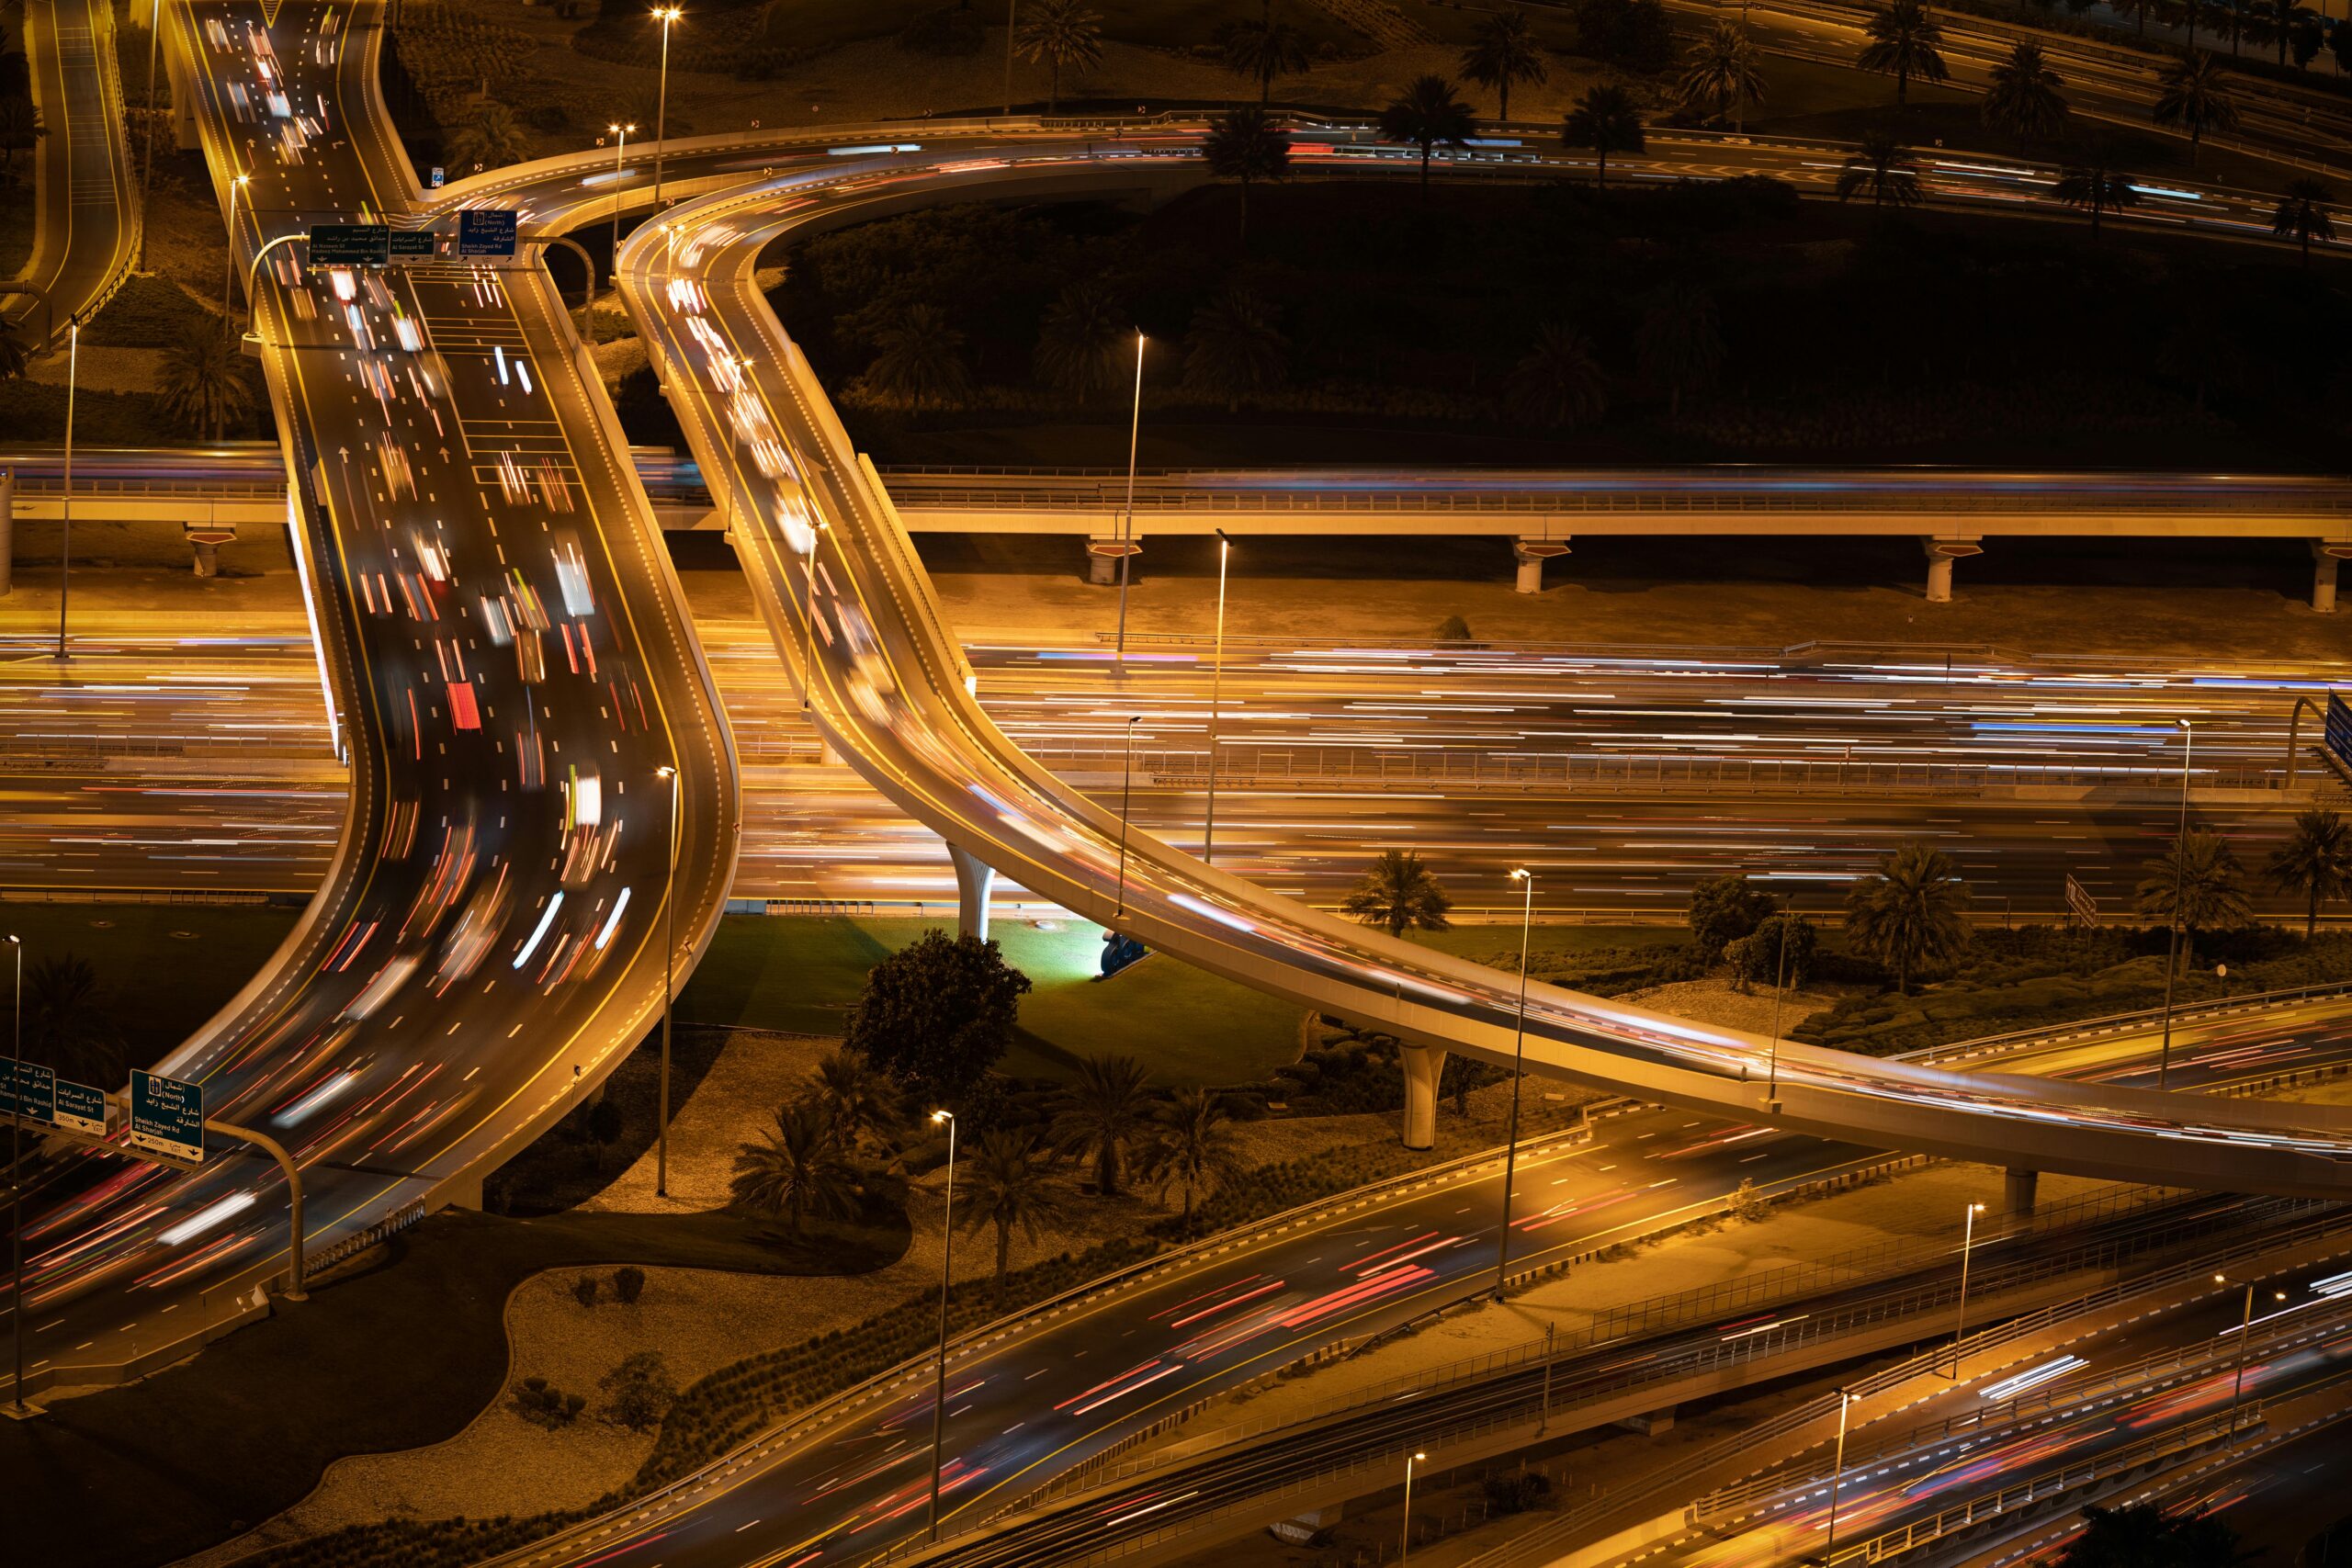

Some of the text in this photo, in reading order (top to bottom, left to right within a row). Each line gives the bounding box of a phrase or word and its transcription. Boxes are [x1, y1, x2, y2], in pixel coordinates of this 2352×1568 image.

[35, 1069, 51, 1078] شارع
[13, 1076, 29, 1085] محد
[86, 1096, 102, 1104] شارع
[162, 1091, 185, 1104] (North)
[33, 1098, 51, 1108] Rashid
[65, 1100, 86, 1111] Sarayat
[146, 1098, 199, 1116] شارع الشيخ زايد
[134, 1116, 180, 1134] Sheikh Zayed Rd
[176, 1116, 199, 1128] الشارقة
[141, 1125, 164, 1135] Sharjah
[147, 1137, 164, 1146] 250m
